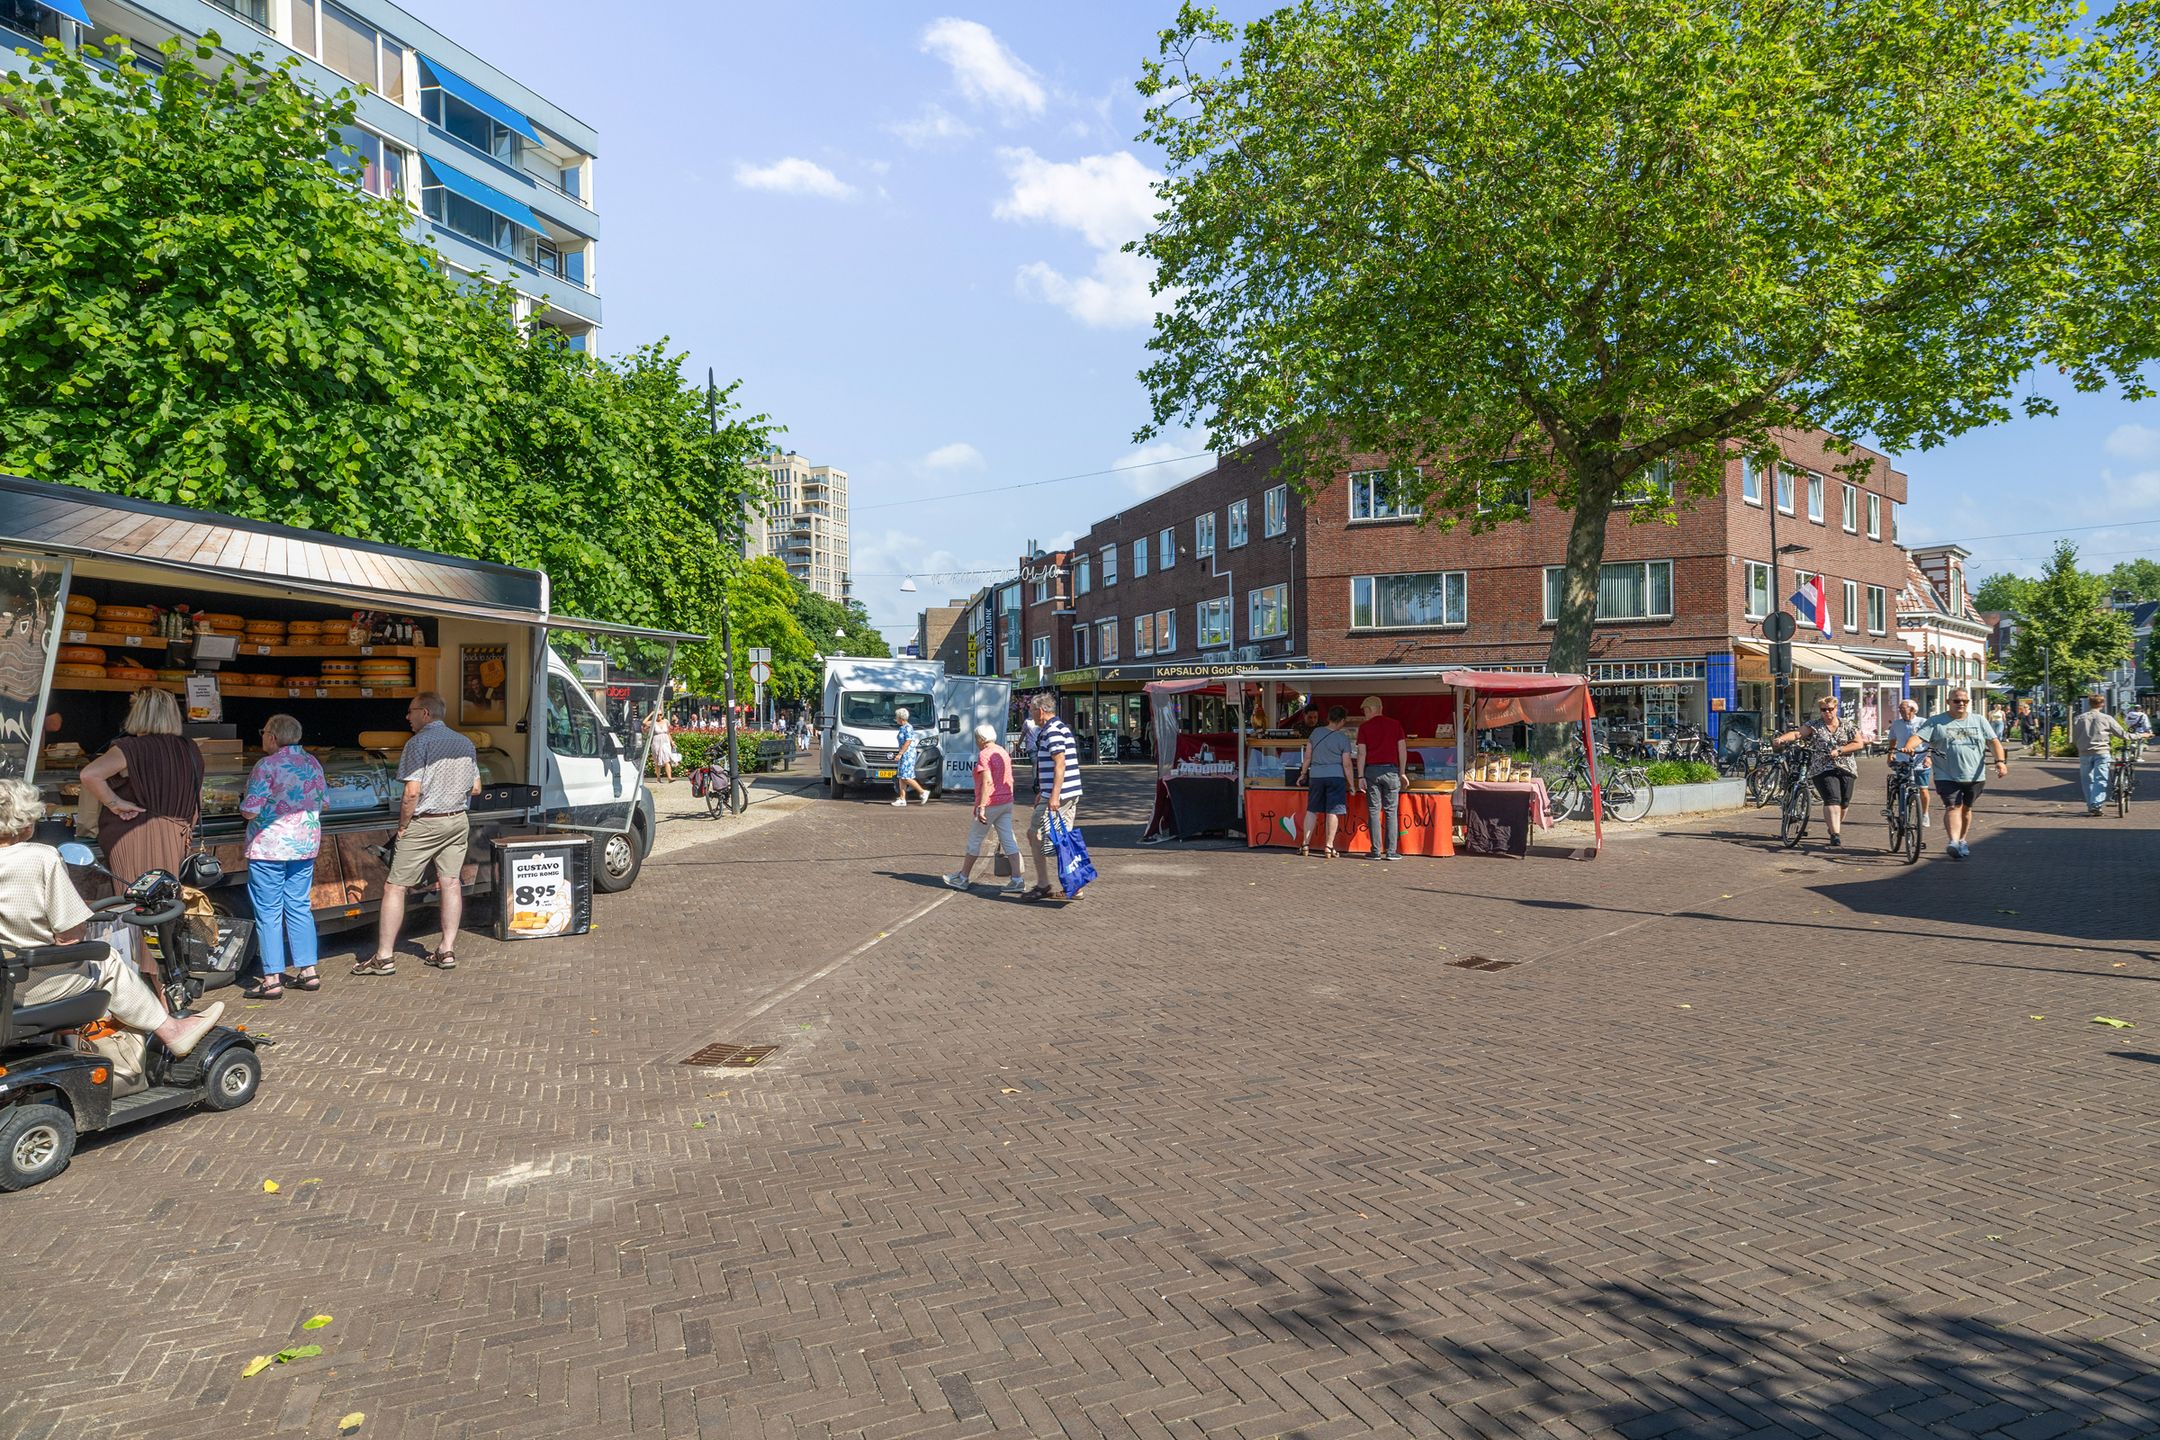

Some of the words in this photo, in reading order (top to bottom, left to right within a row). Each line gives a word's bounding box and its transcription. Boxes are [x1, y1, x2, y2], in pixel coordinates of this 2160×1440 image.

[1156, 666, 1209, 677] KAPSALON
[1211, 665, 1233, 675] Gold
[1615, 686, 1636, 696] HIFI
[1640, 685, 1695, 695] PRODUCT
[517, 863, 559, 872] GUSTAVO
